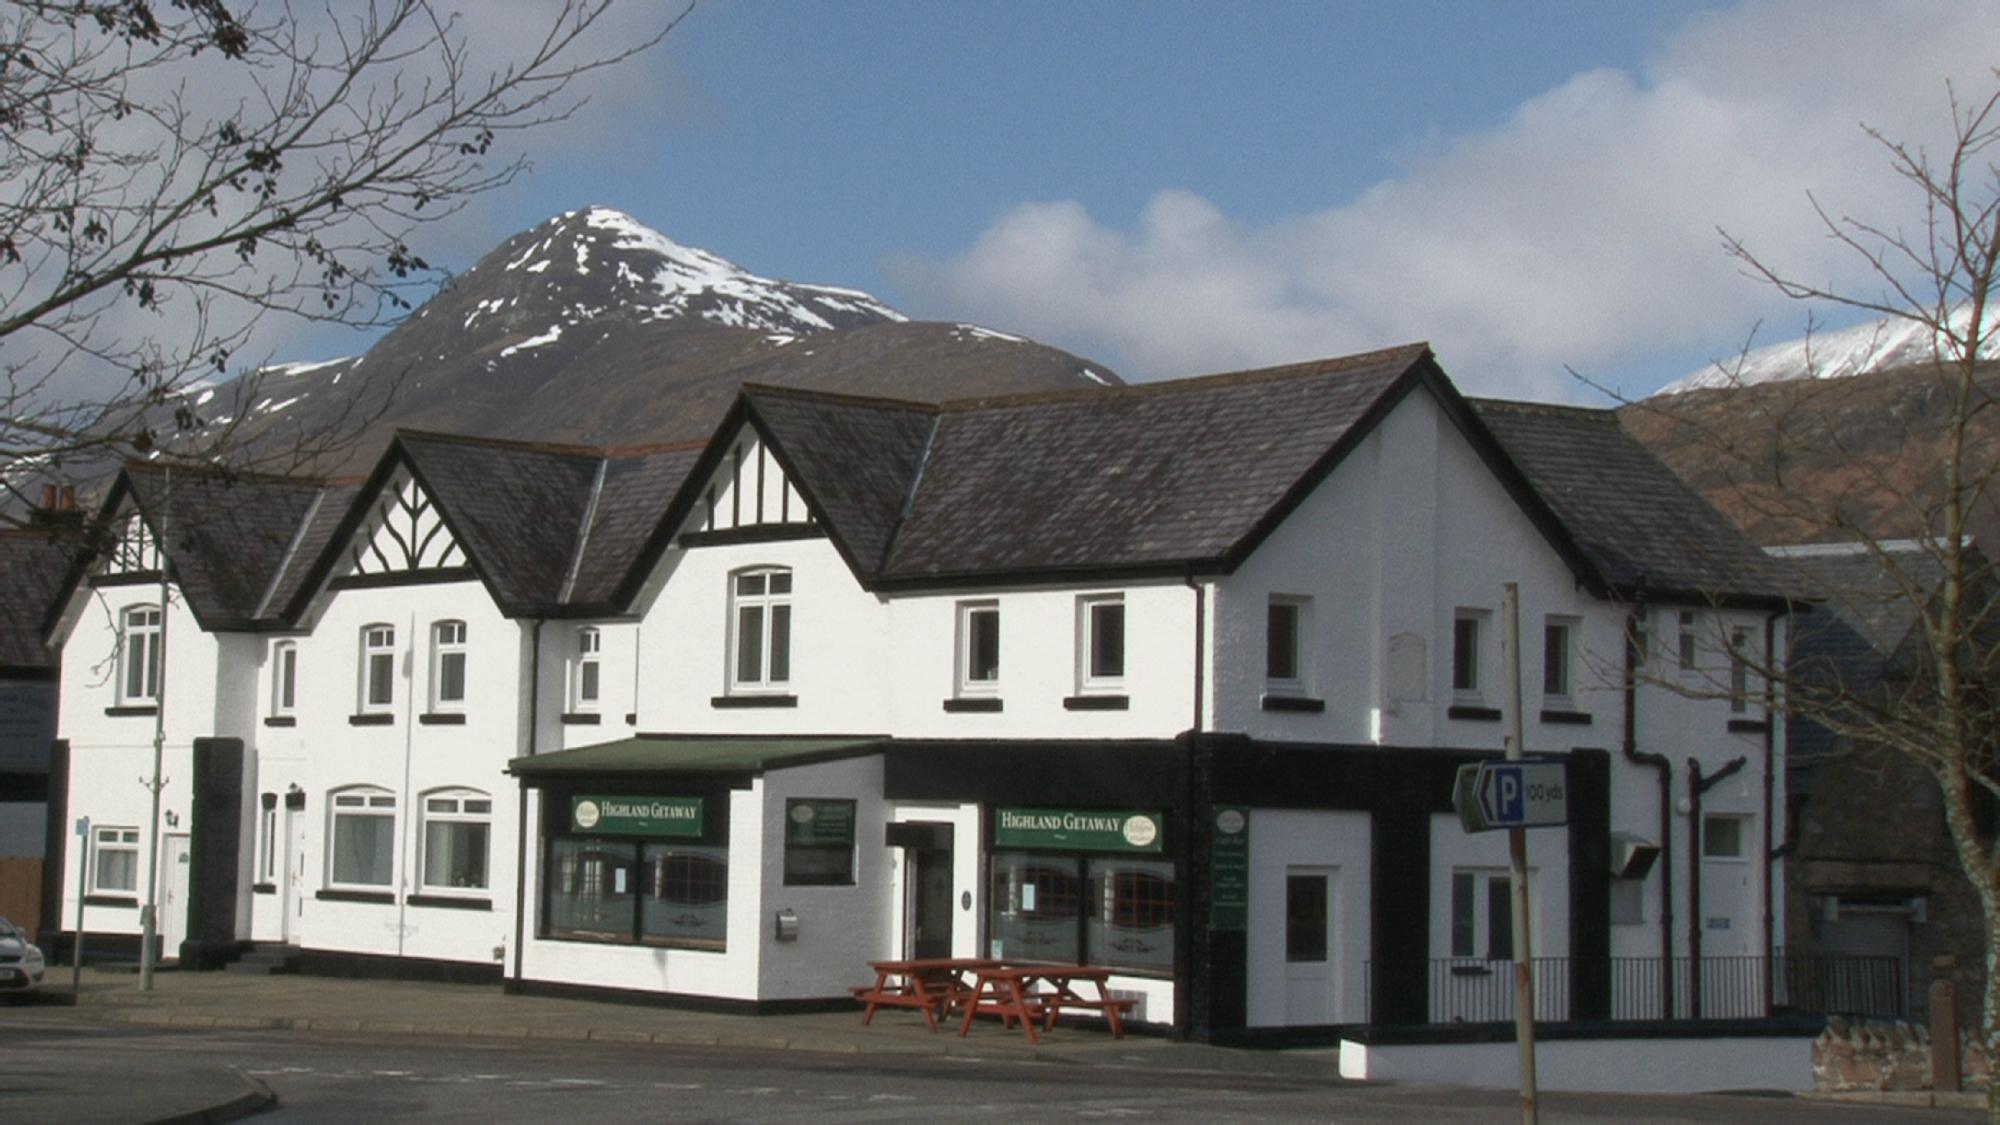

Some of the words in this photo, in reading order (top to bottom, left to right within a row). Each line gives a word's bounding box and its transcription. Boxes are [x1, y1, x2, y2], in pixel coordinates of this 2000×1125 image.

[1501, 775, 1517, 815] P
[1526, 783, 1544, 800] 100
[1546, 783, 1564, 803] yds
[601, 800, 650, 817] HIGHLAND
[651, 801, 697, 819] GETAWAY
[1002, 811, 1061, 830] HIGHLAND
[1063, 812, 1120, 832] GETAWAY
